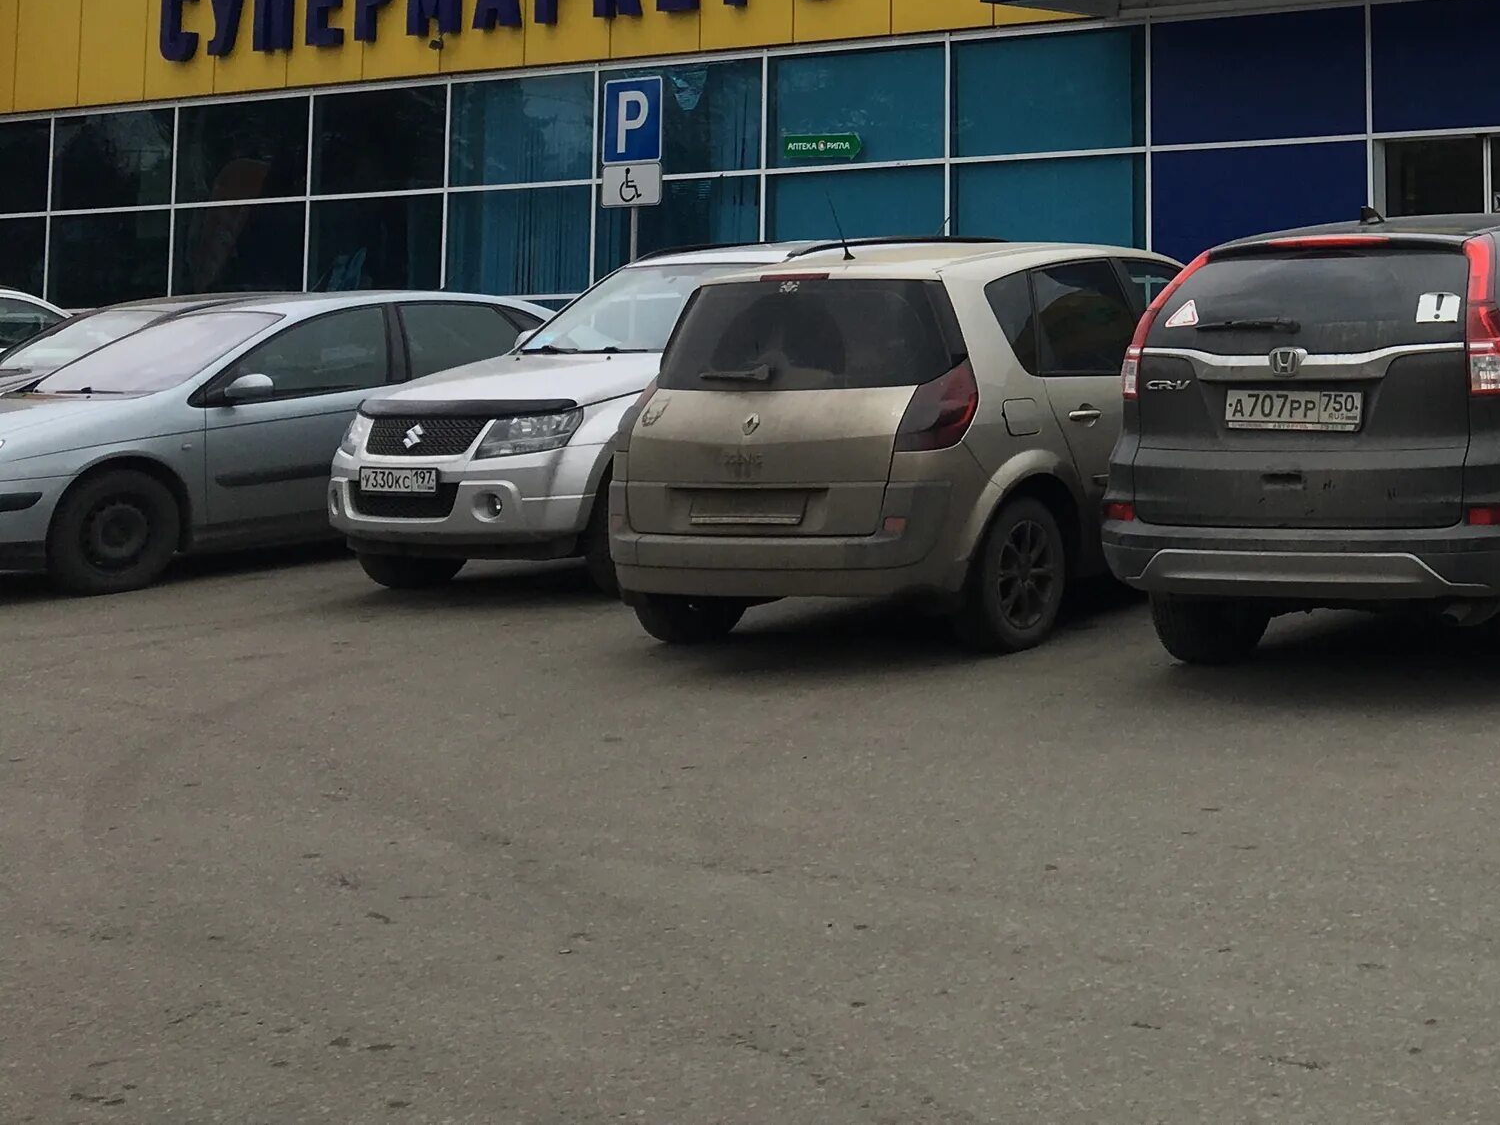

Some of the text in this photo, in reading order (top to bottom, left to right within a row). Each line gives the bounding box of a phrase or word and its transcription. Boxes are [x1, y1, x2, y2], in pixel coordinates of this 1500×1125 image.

[617, 90, 649, 154] P
[787, 141, 850, 150] АПТЕКА РИГЛА
[1231, 393, 1355, 418] А707РР 750
[1328, 413, 1345, 421] RUS
[364, 470, 432, 489] У330КС 197
